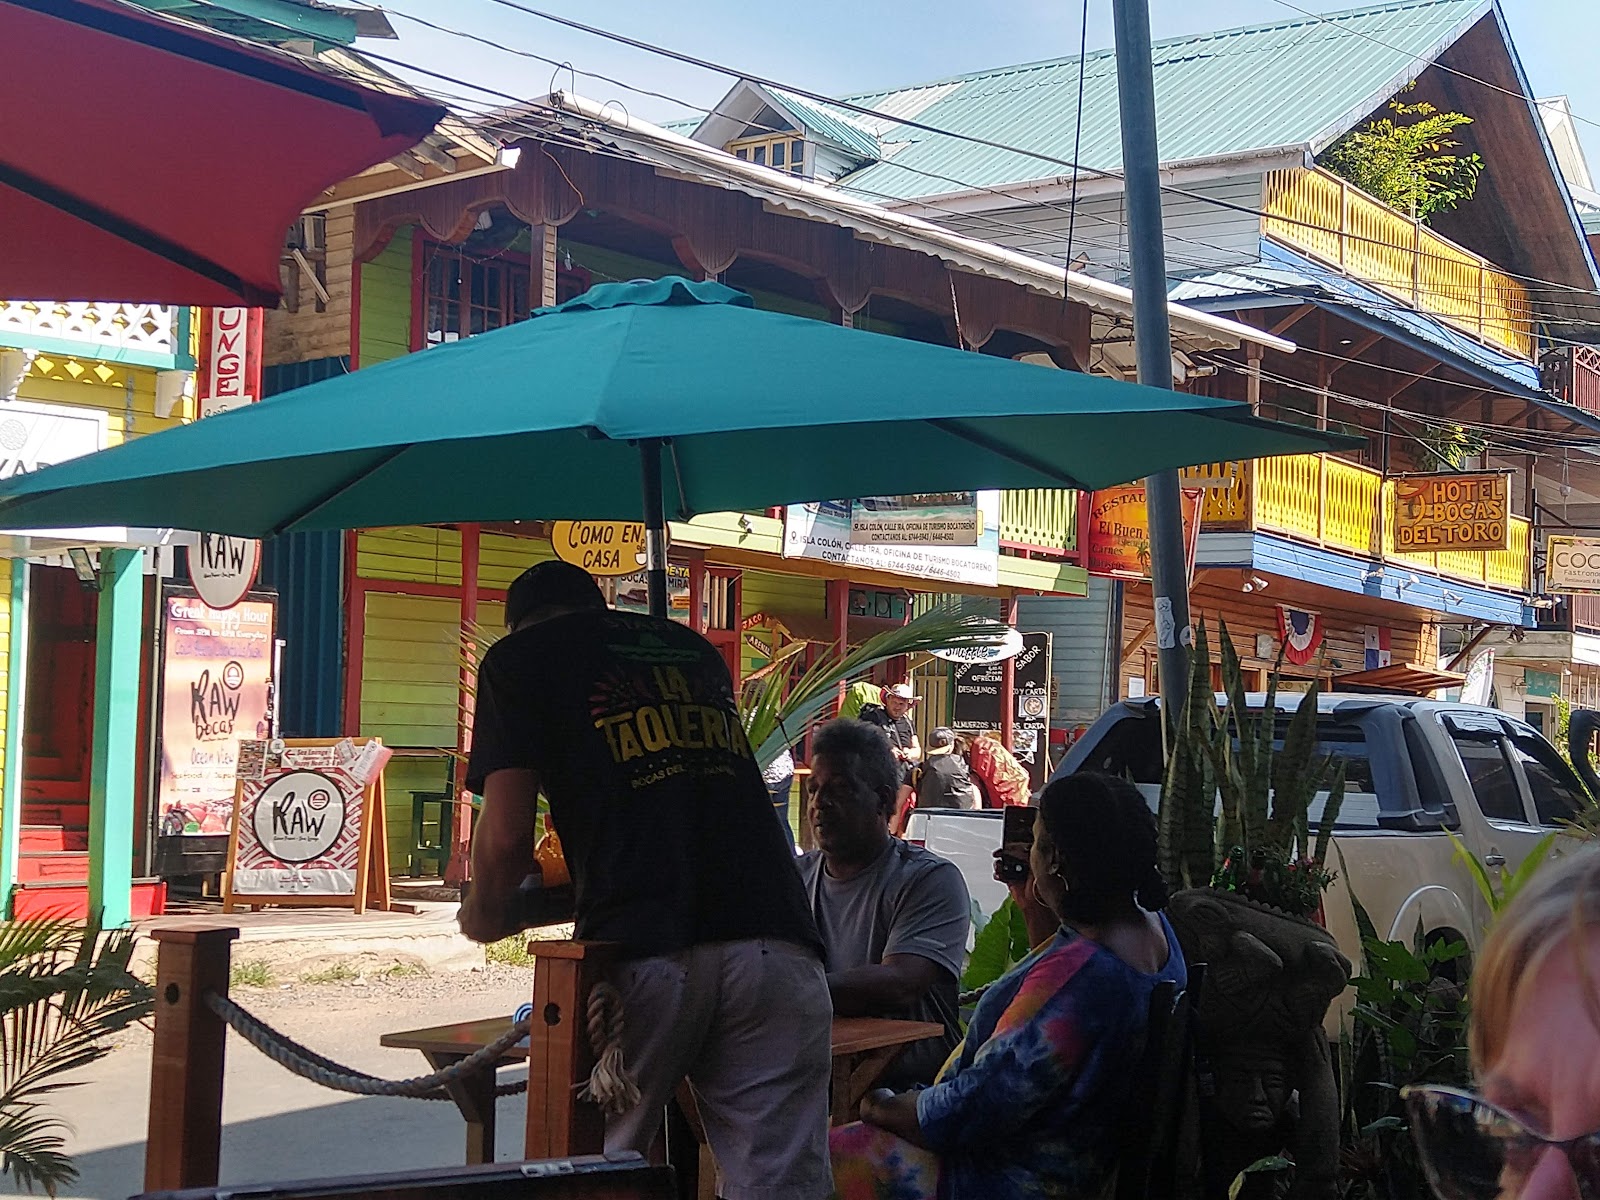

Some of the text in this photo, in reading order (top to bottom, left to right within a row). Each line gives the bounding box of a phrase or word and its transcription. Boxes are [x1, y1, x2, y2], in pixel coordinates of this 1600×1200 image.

[217, 309, 241, 397] UNGE
[1433, 480, 1503, 503] HOTEL
[1092, 493, 1147, 519] RESTAU
[1433, 501, 1503, 522] BOCAS
[568, 520, 642, 549] COMO EN
[1099, 520, 1110, 536] El
[1113, 522, 1143, 539] Buen
[1400, 522, 1503, 544] DEL TORO
[201, 532, 246, 574] RAW
[583, 548, 620, 568] CASA
[800, 535, 816, 546] ISLA
[817, 537, 843, 550] COLÓN,
[845, 542, 866, 553] CALLE
[884, 548, 911, 560] OFICINA
[913, 550, 922, 561] DE
[925, 553, 950, 565] TURISMO
[822, 551, 874, 566] CONTACTANOS
[1092, 543, 1124, 556] Carnes
[667, 578, 690, 589] MIRA
[243, 606, 269, 622] Hour
[742, 613, 762, 630] JACO
[1015, 645, 1041, 671] SABOR
[651, 665, 694, 703] LA
[957, 685, 997, 696] DESAYUNOS
[190, 669, 241, 724] RAW
[195, 715, 235, 740] bocas
[952, 720, 990, 729] ALMUERZOS
[630, 769, 665, 791] BOCAS
[272, 791, 326, 837] RAW
